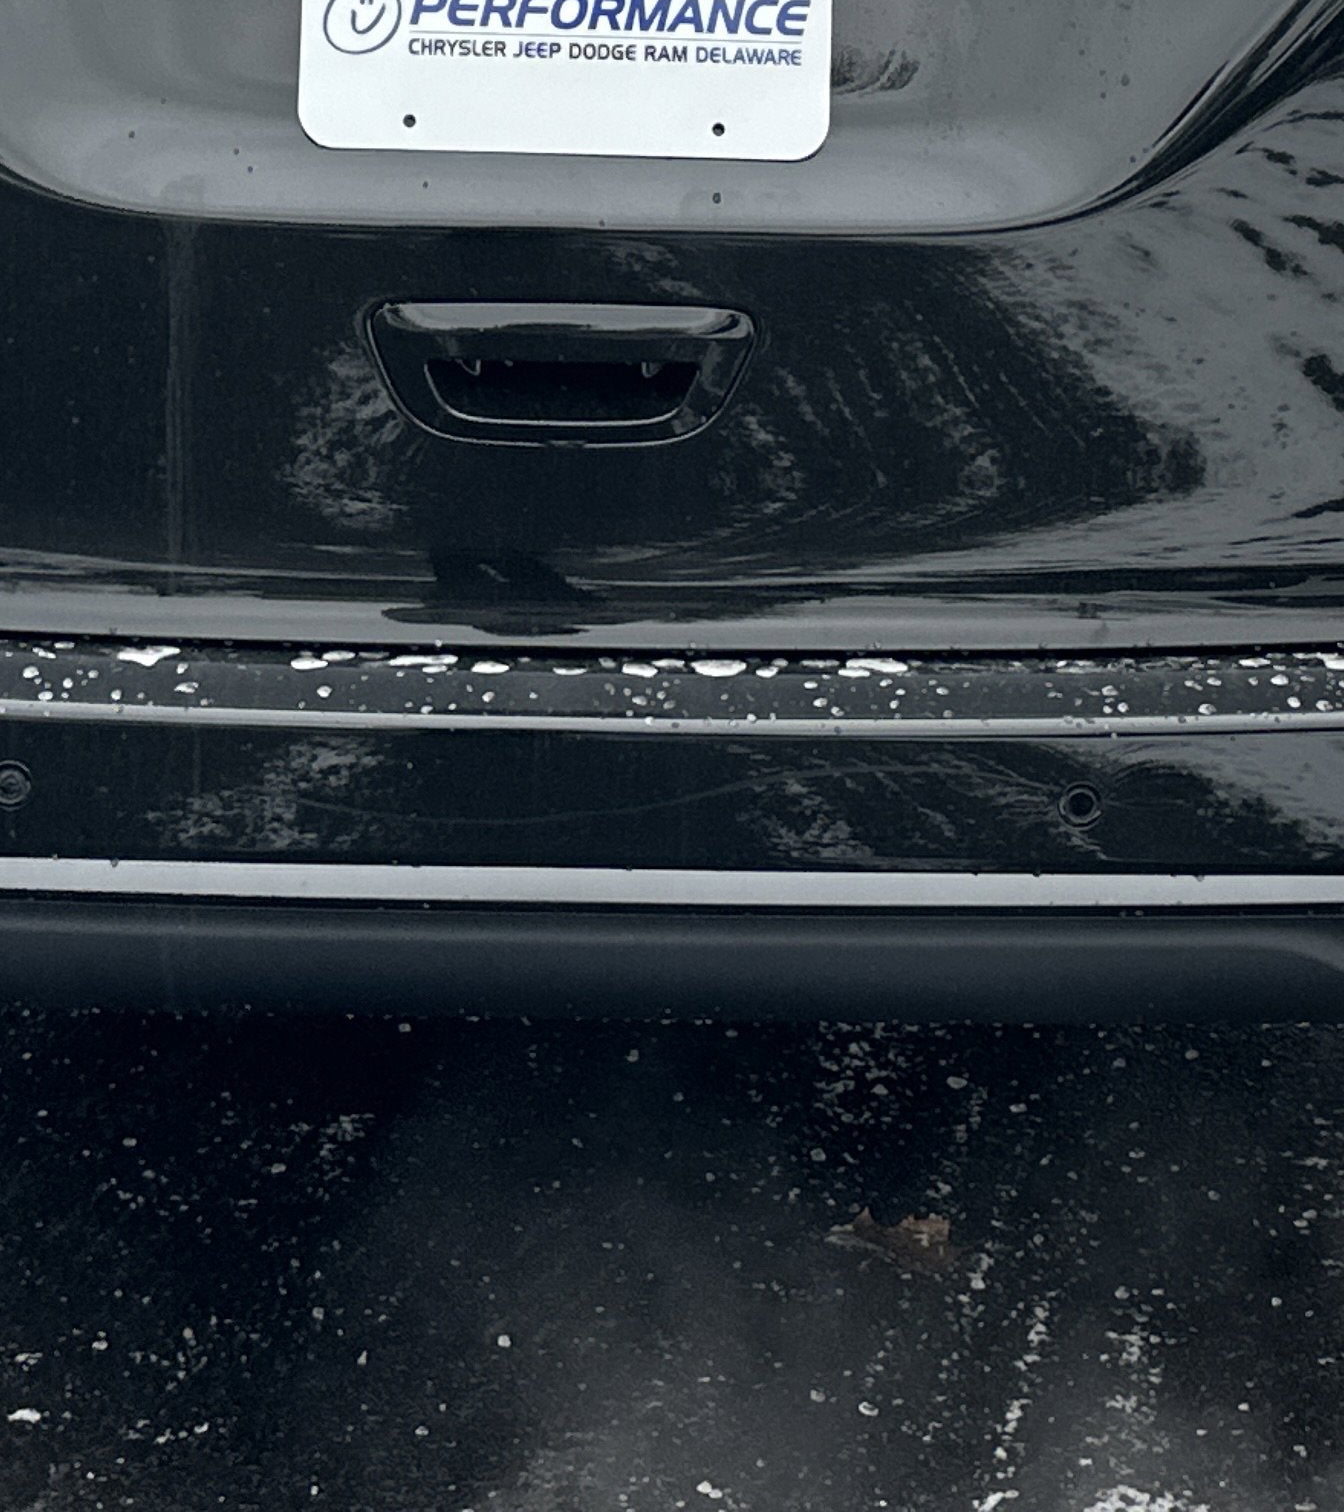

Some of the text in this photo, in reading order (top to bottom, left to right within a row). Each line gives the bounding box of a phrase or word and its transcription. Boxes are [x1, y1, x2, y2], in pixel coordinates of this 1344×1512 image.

[408, 37, 803, 67] CHRYSLER JEEP DODGE RAM DELAWARE
